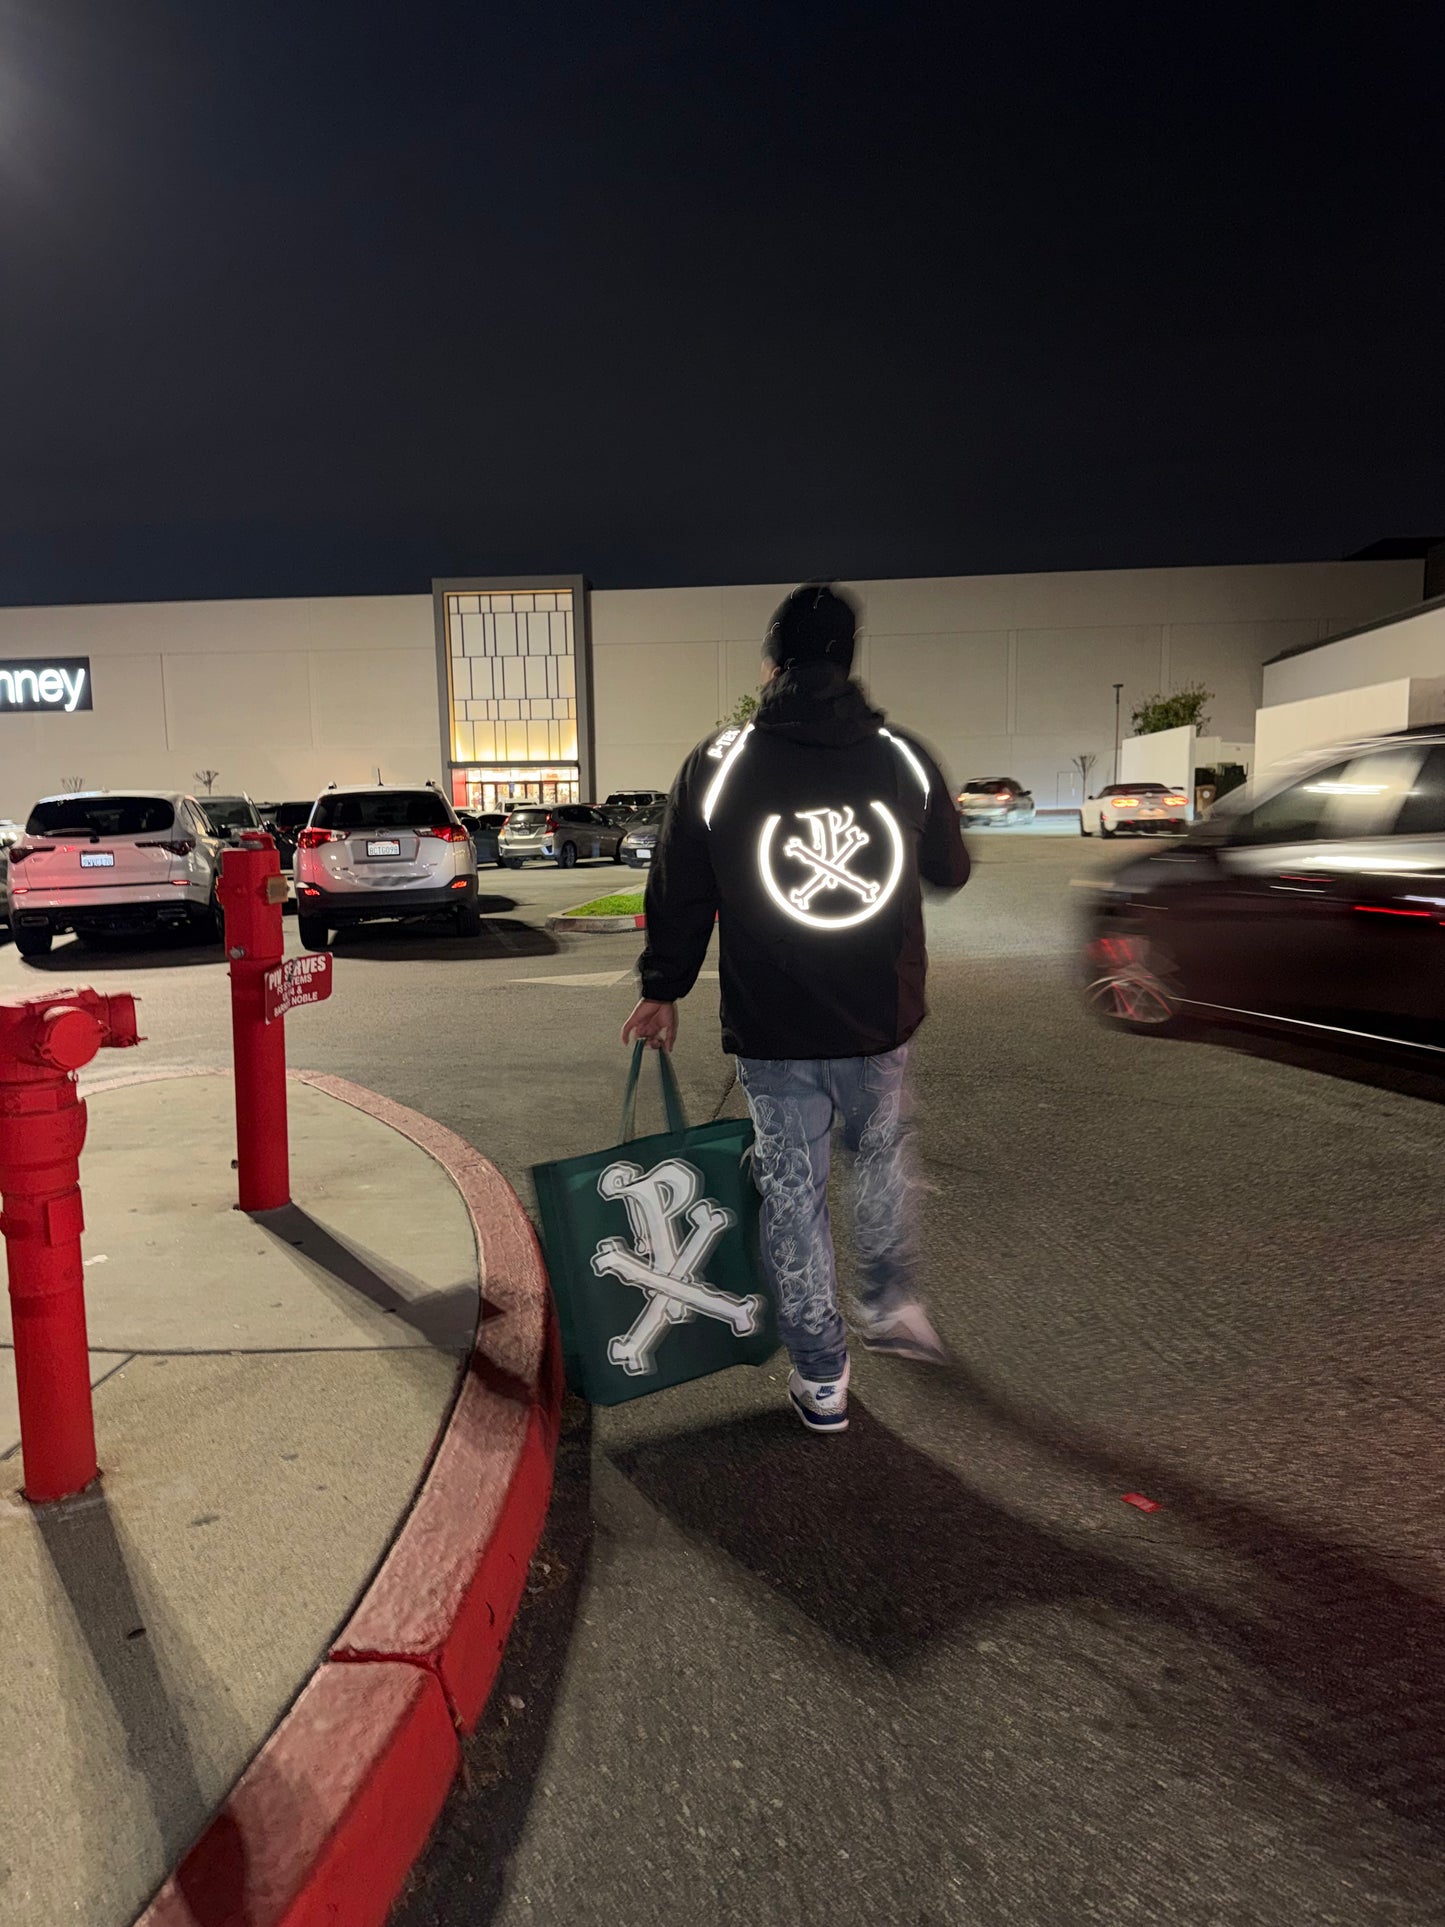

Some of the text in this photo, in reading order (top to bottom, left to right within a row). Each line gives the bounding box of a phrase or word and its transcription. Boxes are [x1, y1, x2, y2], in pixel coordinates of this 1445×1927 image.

[0, 668, 85, 712] nney
[284, 955, 327, 981] SERVES
[284, 973, 313, 991] SSTEMS
[291, 991, 319, 1006] NOBLE
